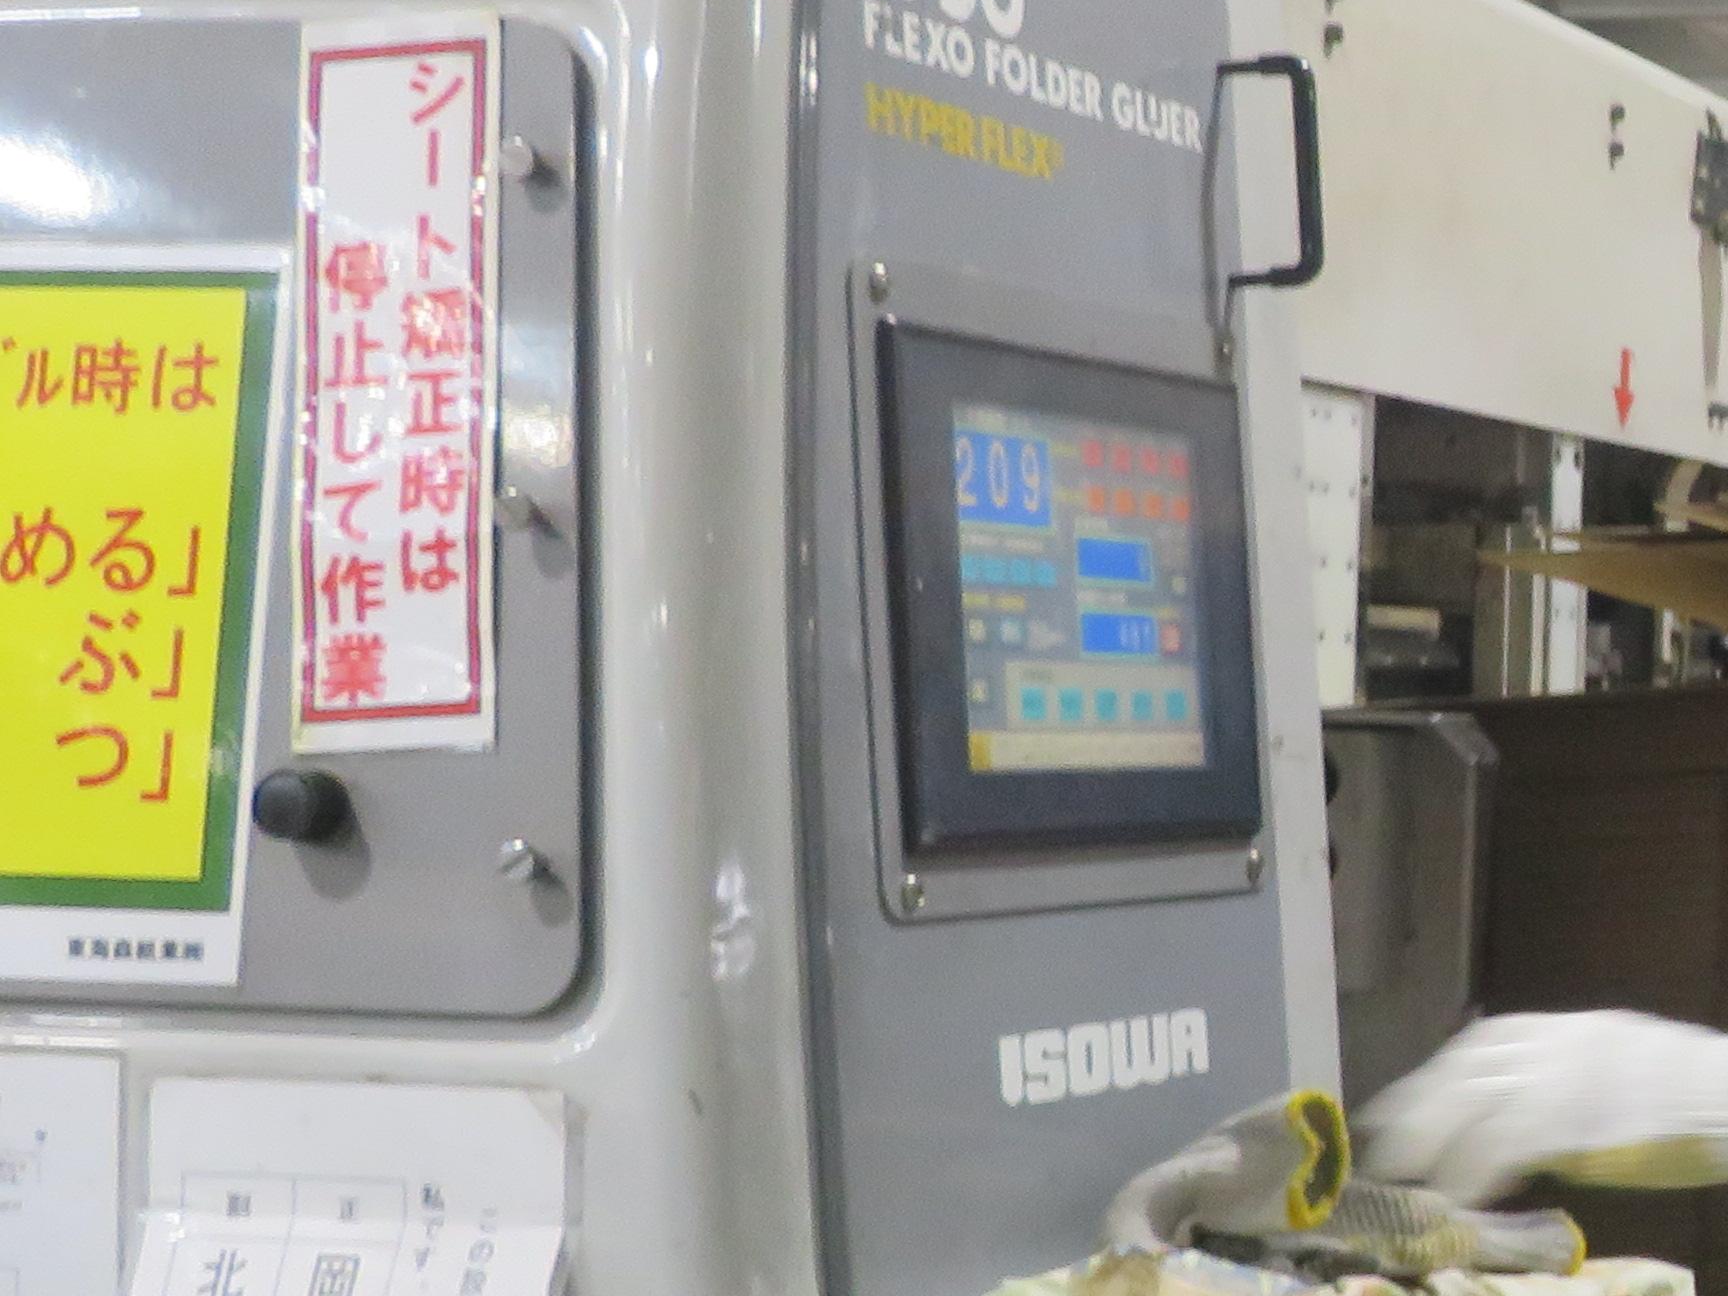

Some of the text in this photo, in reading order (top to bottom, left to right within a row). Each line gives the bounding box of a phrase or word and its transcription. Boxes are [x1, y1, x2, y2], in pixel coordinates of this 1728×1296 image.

[984, 37, 1104, 122] FOLDER
[1111, 81, 1203, 154] GLUER
[2, 336, 219, 414] ル時は
[320, 242, 388, 706] 停止して作業
[957, 437, 1041, 512] 209
[999, 1007, 1209, 1106] ISOWA
